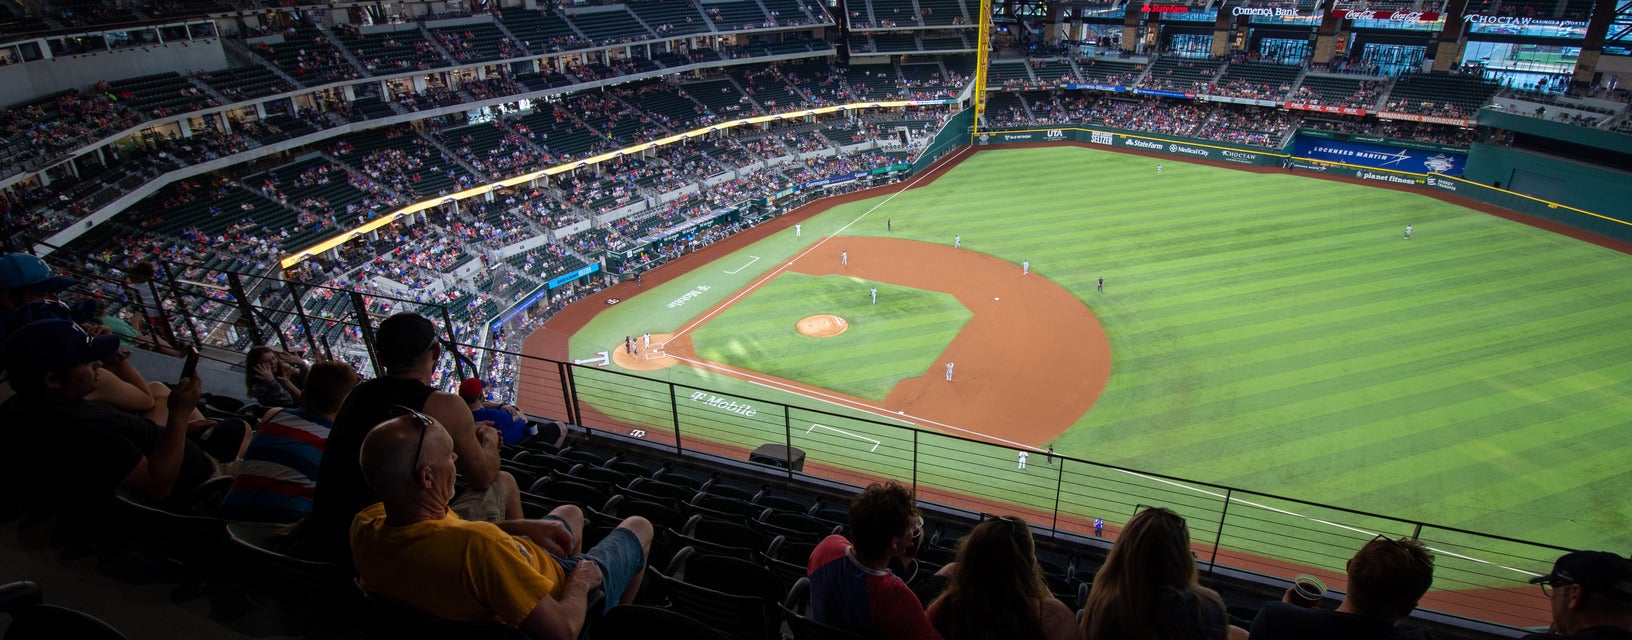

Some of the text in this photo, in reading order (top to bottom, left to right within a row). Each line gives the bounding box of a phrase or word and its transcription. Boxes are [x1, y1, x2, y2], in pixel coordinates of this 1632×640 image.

[1274, 7, 1299, 16] Bank
[1469, 14, 1532, 25] CHOCTAW
[1047, 129, 1063, 137] UTA
[1223, 150, 1256, 160] CHOCTAW
[1314, 146, 1389, 161] LOCKHEED MARTIN
[1363, 172, 1415, 185] planet fitness
